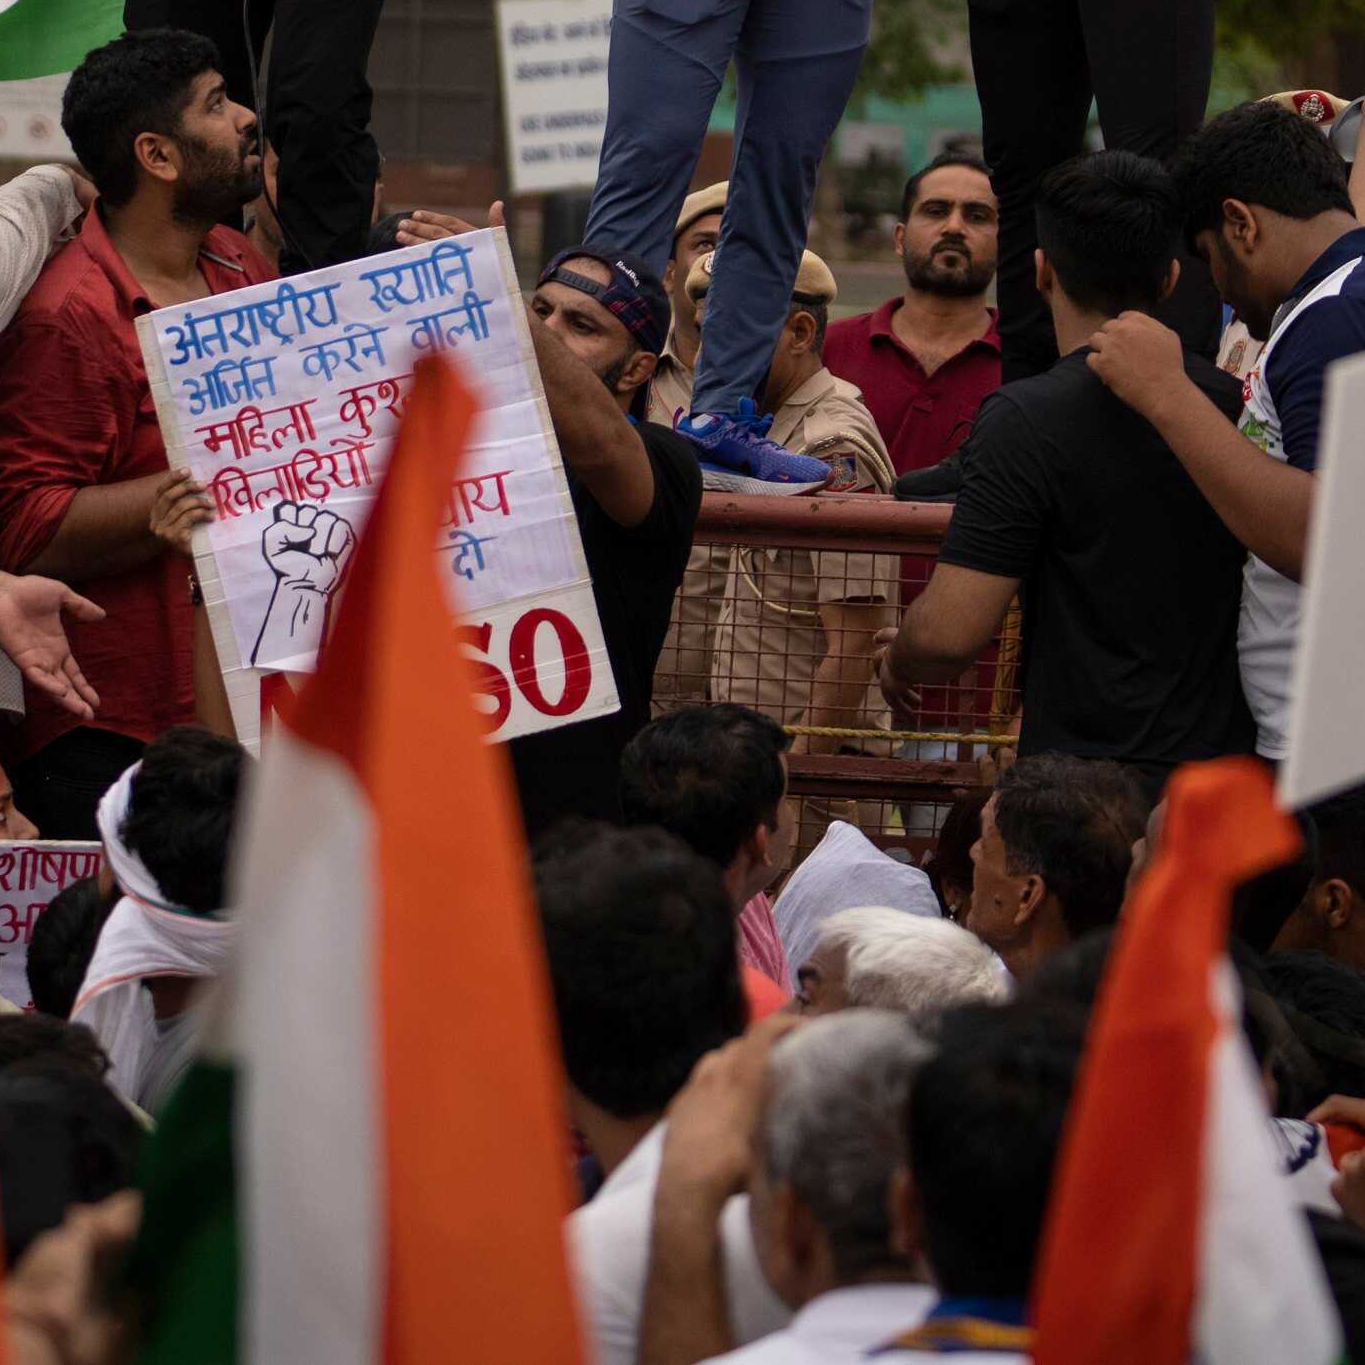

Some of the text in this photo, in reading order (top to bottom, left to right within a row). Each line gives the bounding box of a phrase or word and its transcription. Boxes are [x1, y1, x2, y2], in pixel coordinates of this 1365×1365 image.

[298, 322, 391, 382] करने
[406, 291, 493, 352] वाली
[194, 397, 318, 460] महिला
